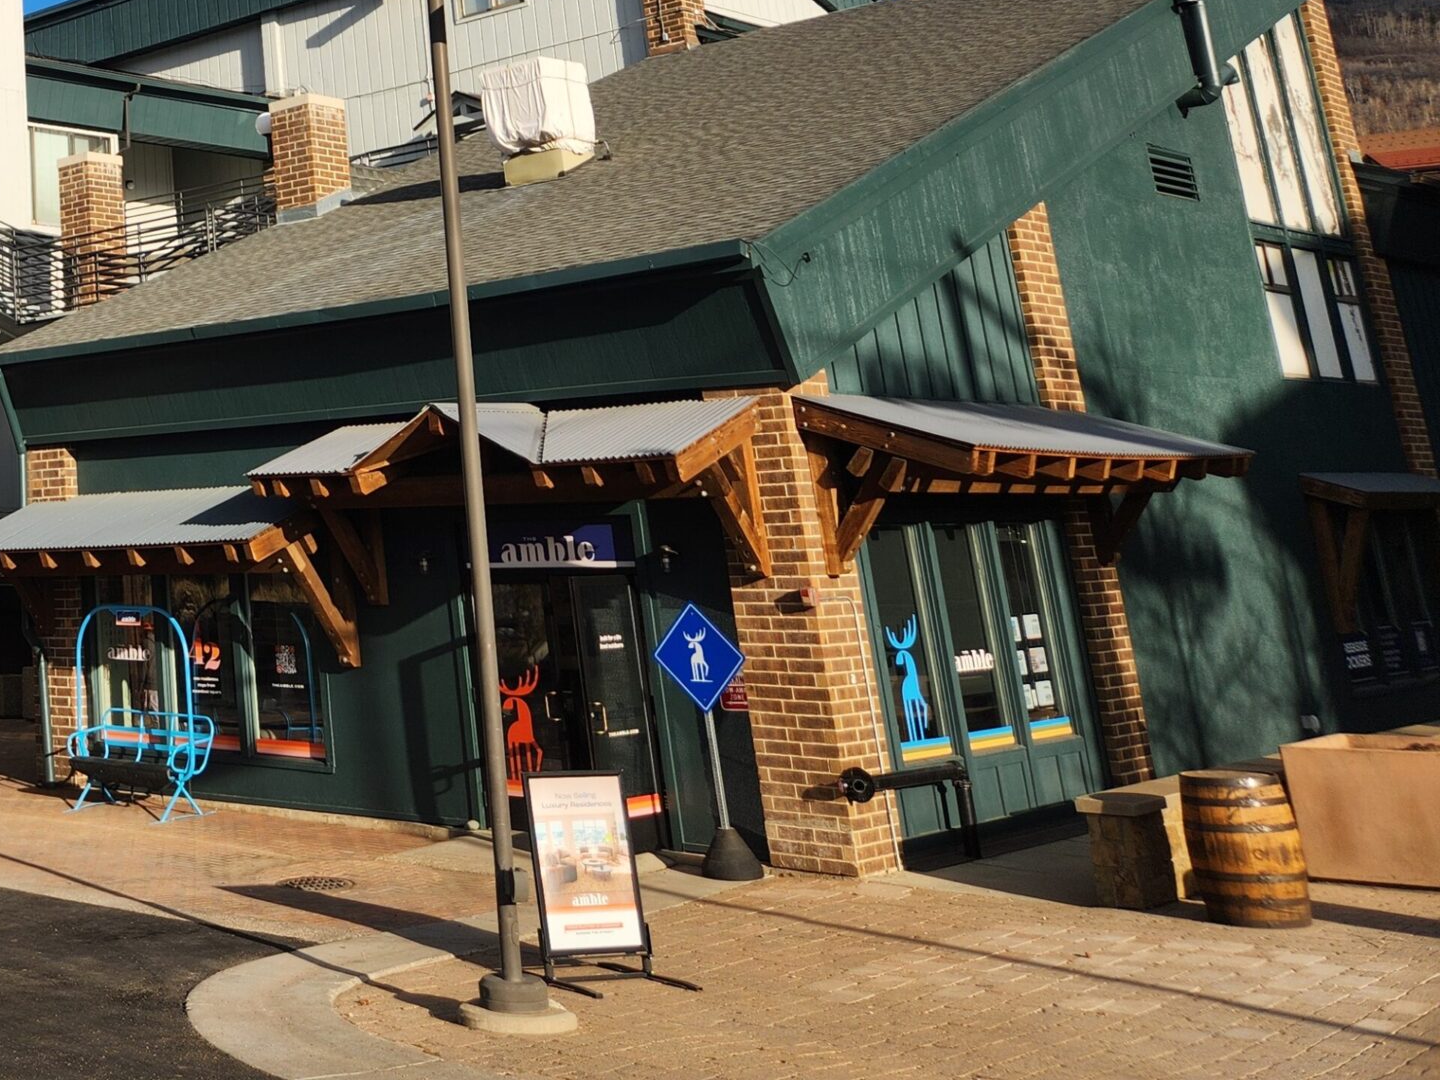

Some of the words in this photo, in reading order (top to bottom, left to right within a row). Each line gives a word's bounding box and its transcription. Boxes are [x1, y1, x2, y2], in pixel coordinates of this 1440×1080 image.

[501, 535, 595, 563] amble
[107, 644, 151, 661] amble
[189, 637, 221, 670] 42
[572, 892, 609, 907] amble
